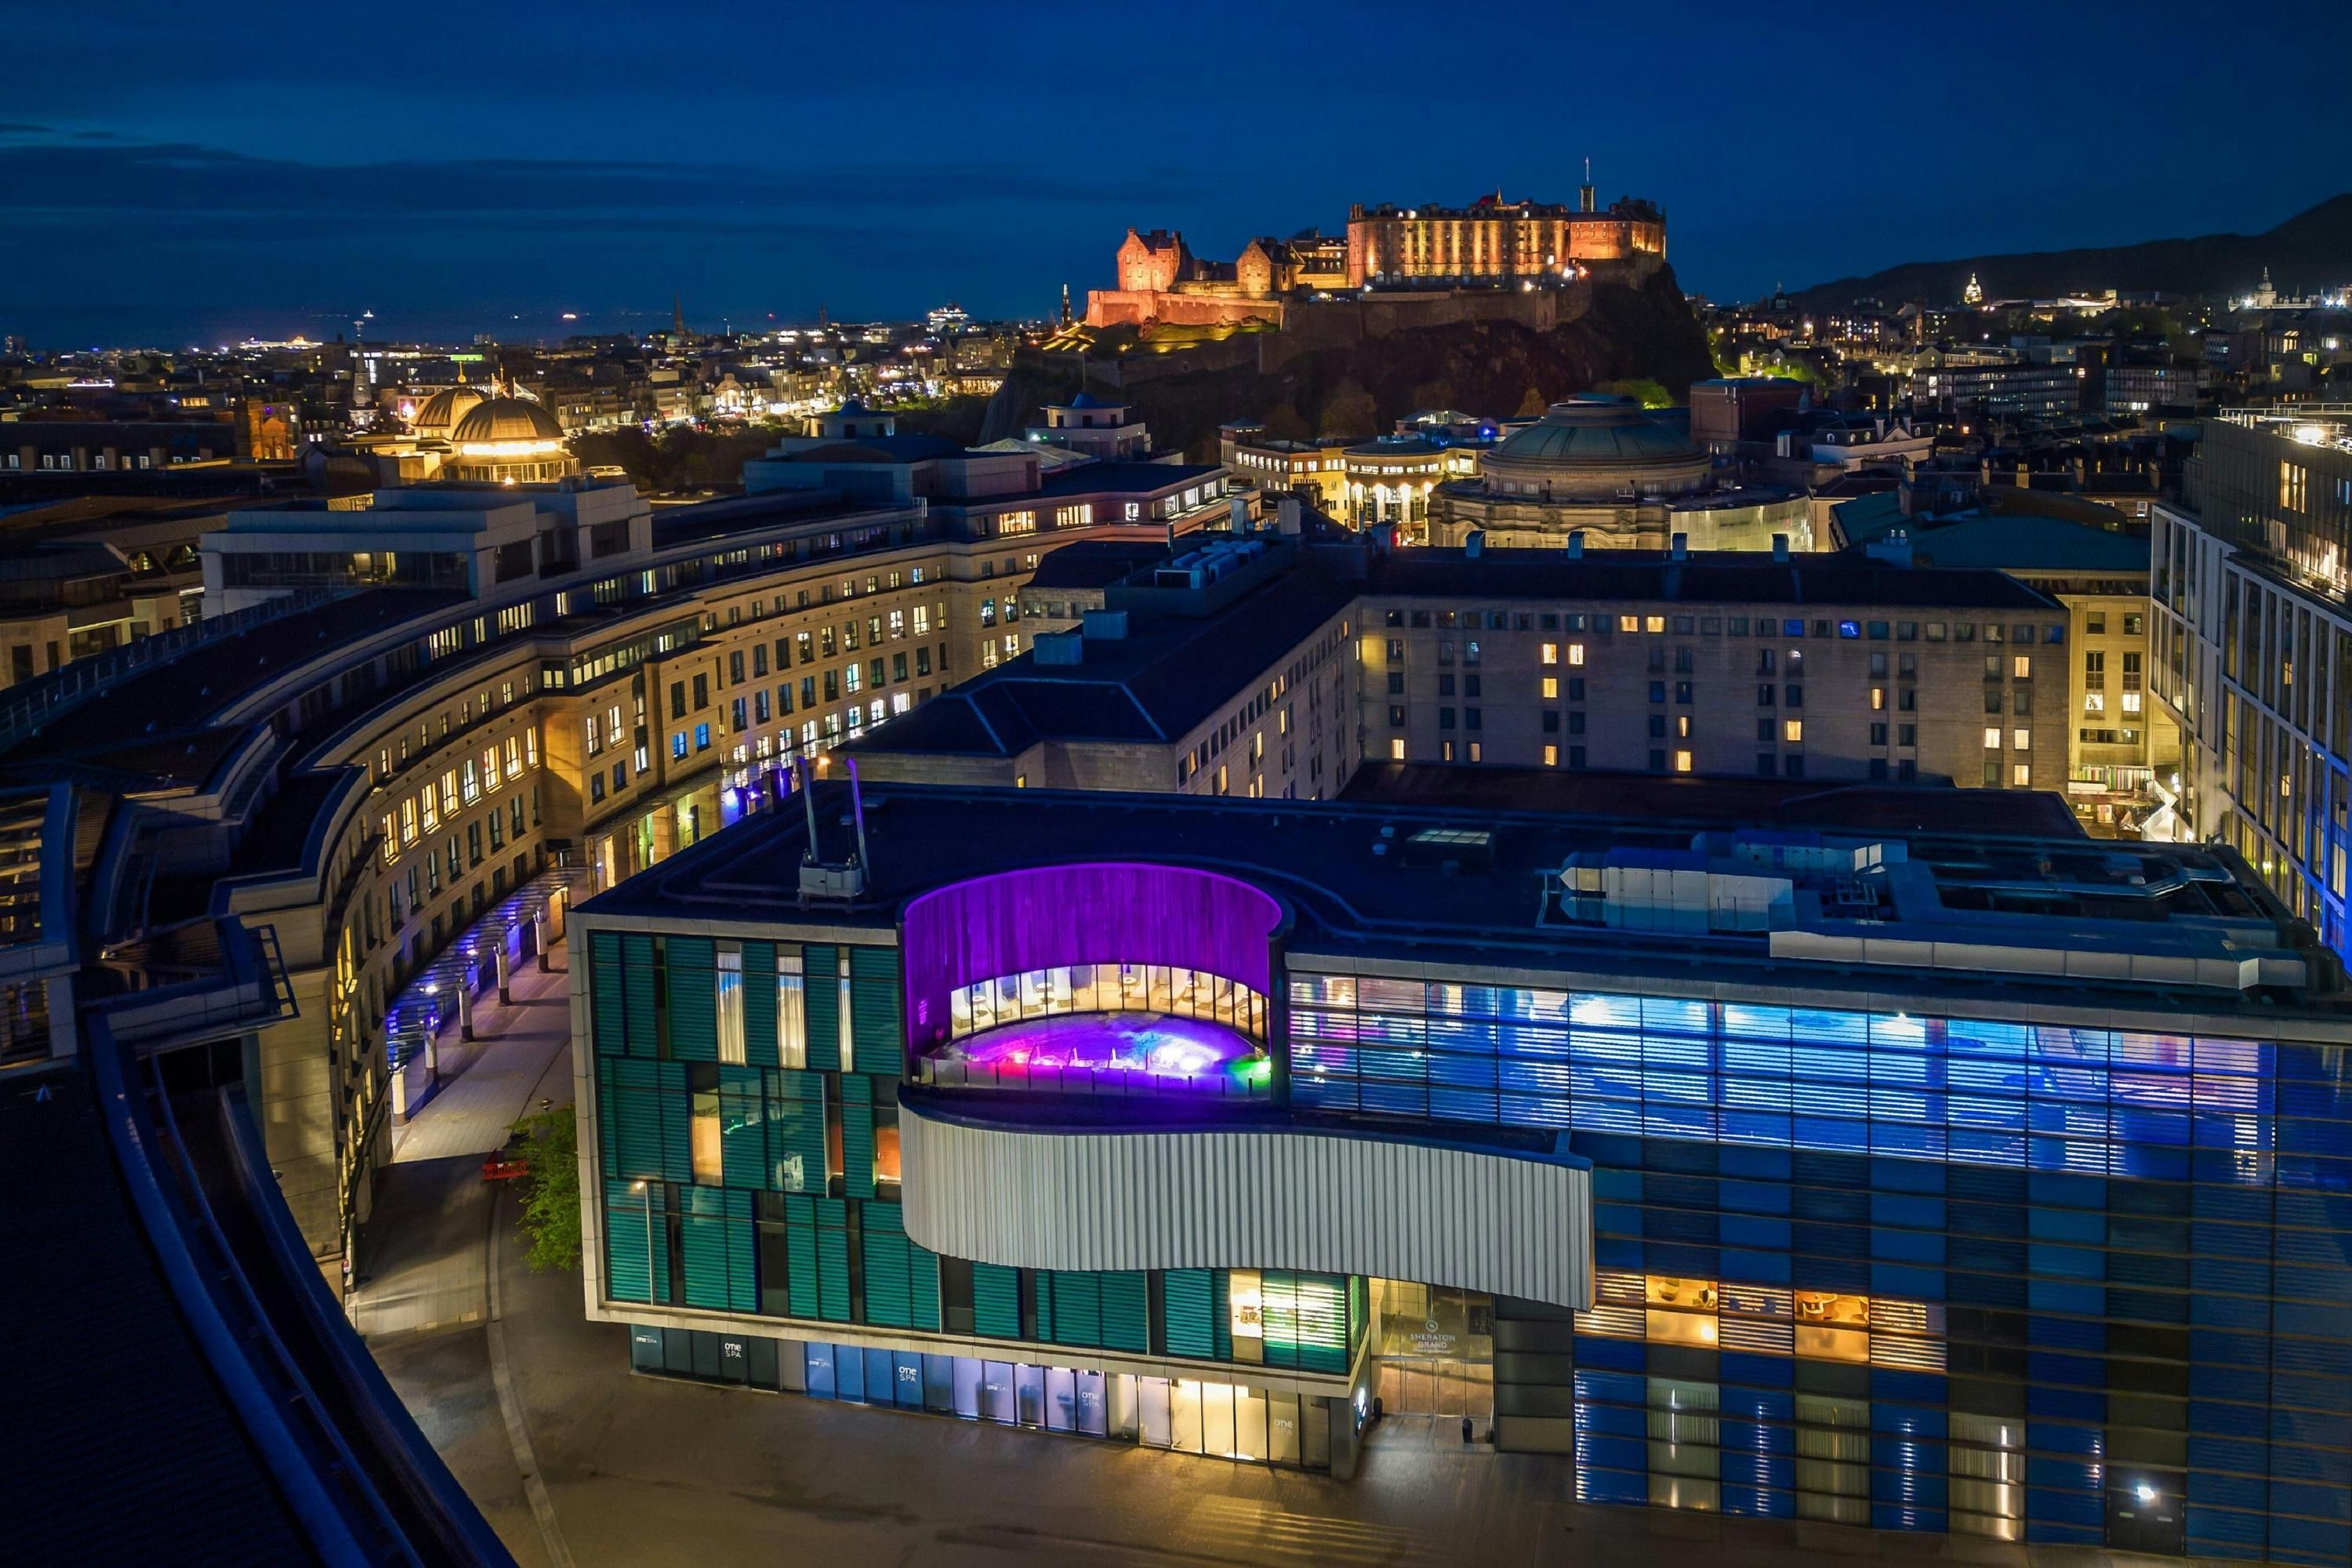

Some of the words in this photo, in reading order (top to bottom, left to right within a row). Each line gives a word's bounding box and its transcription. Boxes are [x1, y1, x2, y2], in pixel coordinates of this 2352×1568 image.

[1410, 1333, 1456, 1341] SHERATON
[724, 1342, 742, 1352] one
[1417, 1341, 1448, 1349] GRAND
[725, 1350, 742, 1359] SPA
[898, 1366, 917, 1376] one
[900, 1374, 916, 1383] SPA
[1082, 1391, 1100, 1402] one
[1273, 1418, 1293, 1429] one
